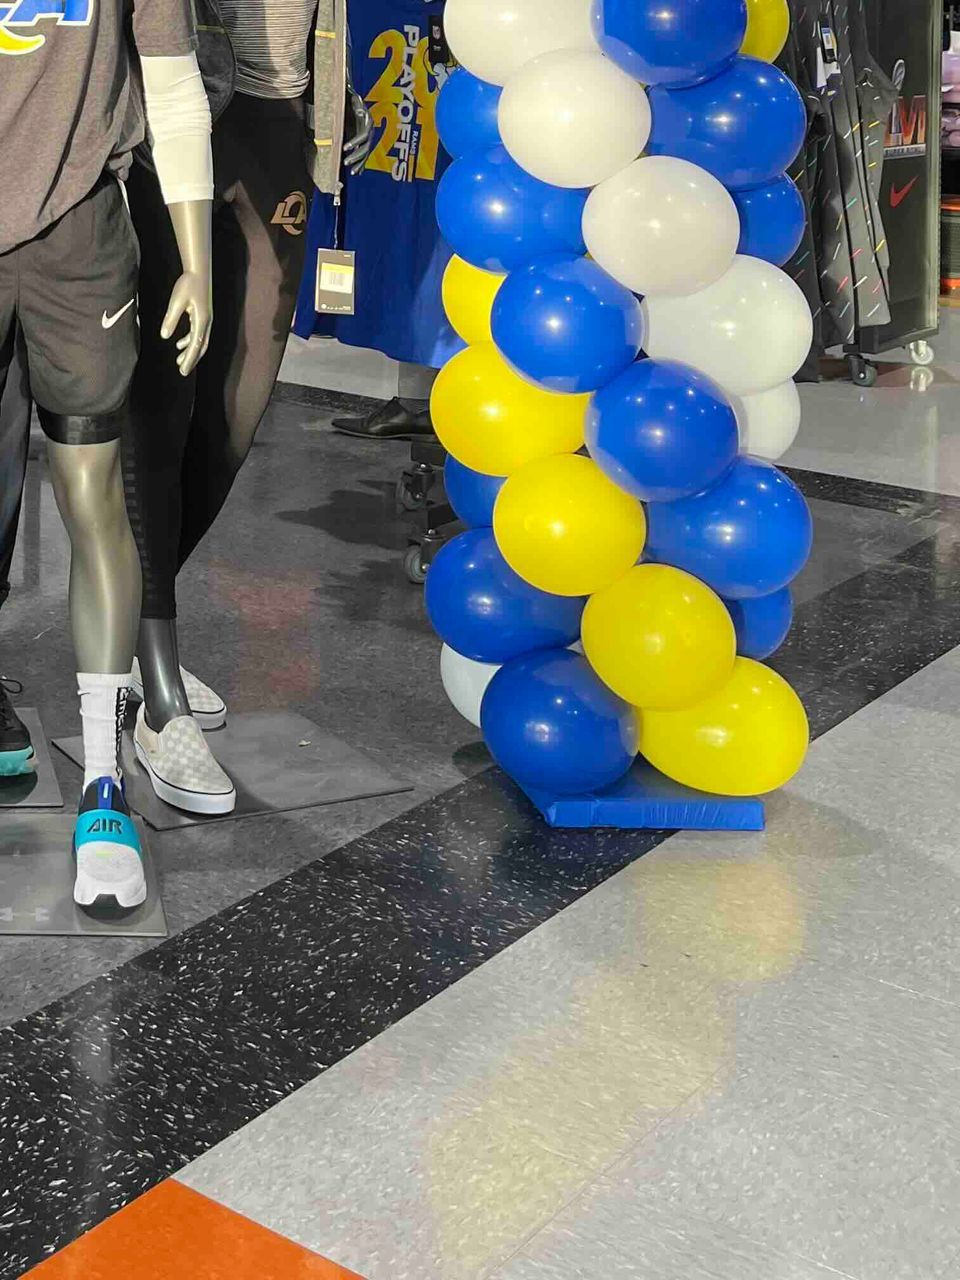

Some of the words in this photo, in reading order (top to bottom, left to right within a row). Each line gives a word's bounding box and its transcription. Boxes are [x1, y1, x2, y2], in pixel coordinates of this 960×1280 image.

[391, 24, 420, 182] PLAYOFFS
[409, 130, 419, 154] RAMS
[87, 818, 123, 835] AIR
